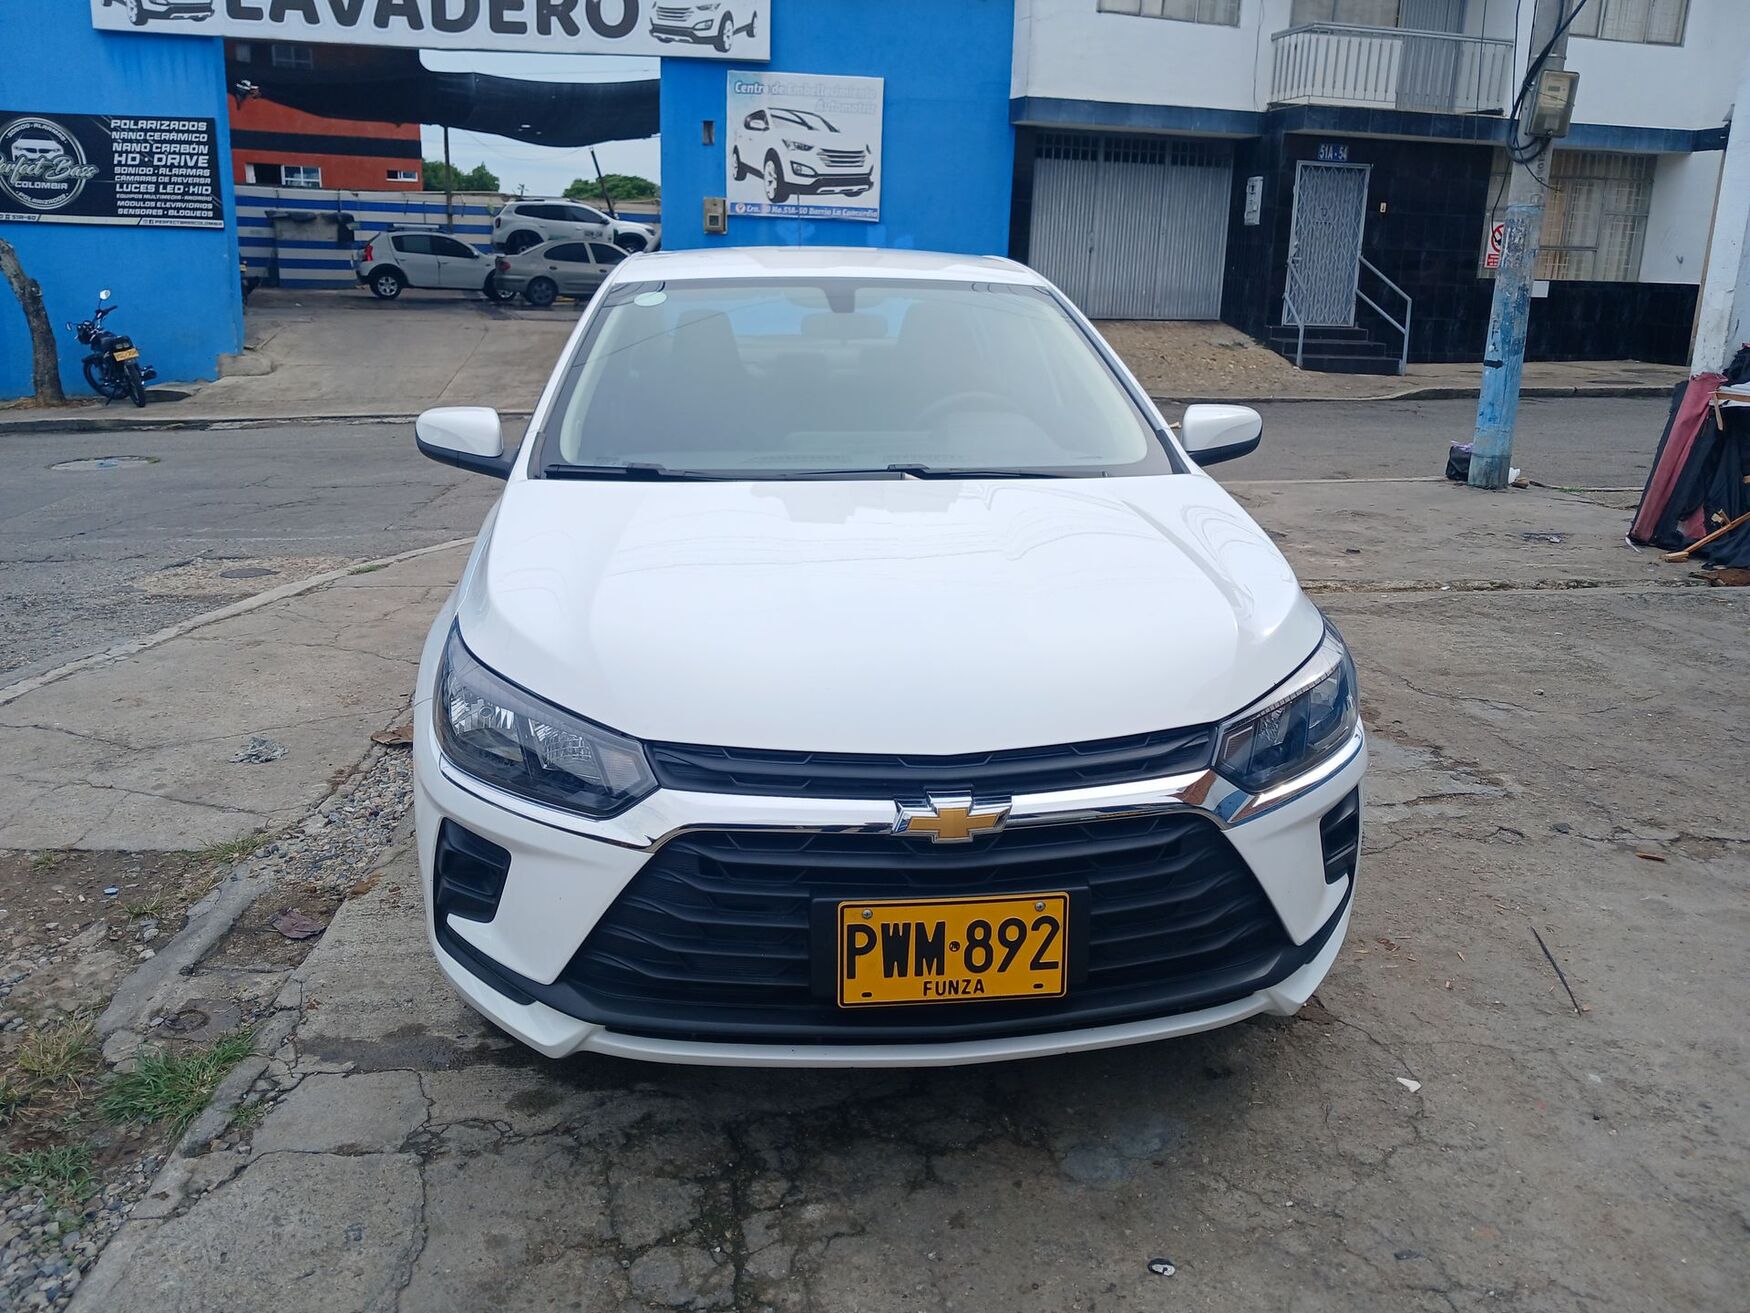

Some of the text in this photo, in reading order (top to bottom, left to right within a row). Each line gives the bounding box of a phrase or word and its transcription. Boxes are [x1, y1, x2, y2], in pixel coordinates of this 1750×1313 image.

[735, 81, 769, 95] Centro
[111, 119, 207, 131] POLARIZADOS
[111, 131, 208, 142] NANO CERÁMICO
[112, 142, 209, 154] NANO CARBÓN
[113, 153, 210, 168] HD DRIVE
[0, 154, 98, 184] erfect Bass
[114, 166, 211, 177] SONIDO ALARMAS
[15, 180, 69, 190] COLOMBIA
[171, 176, 212, 185] REVERSA
[116, 183, 156, 193] LUCES
[159, 184, 184, 194] LED
[117, 208, 214, 218] SENSORES BLOQUEOS
[846, 915, 1060, 980] PWM 892
[923, 978, 985, 997] FUNZA
